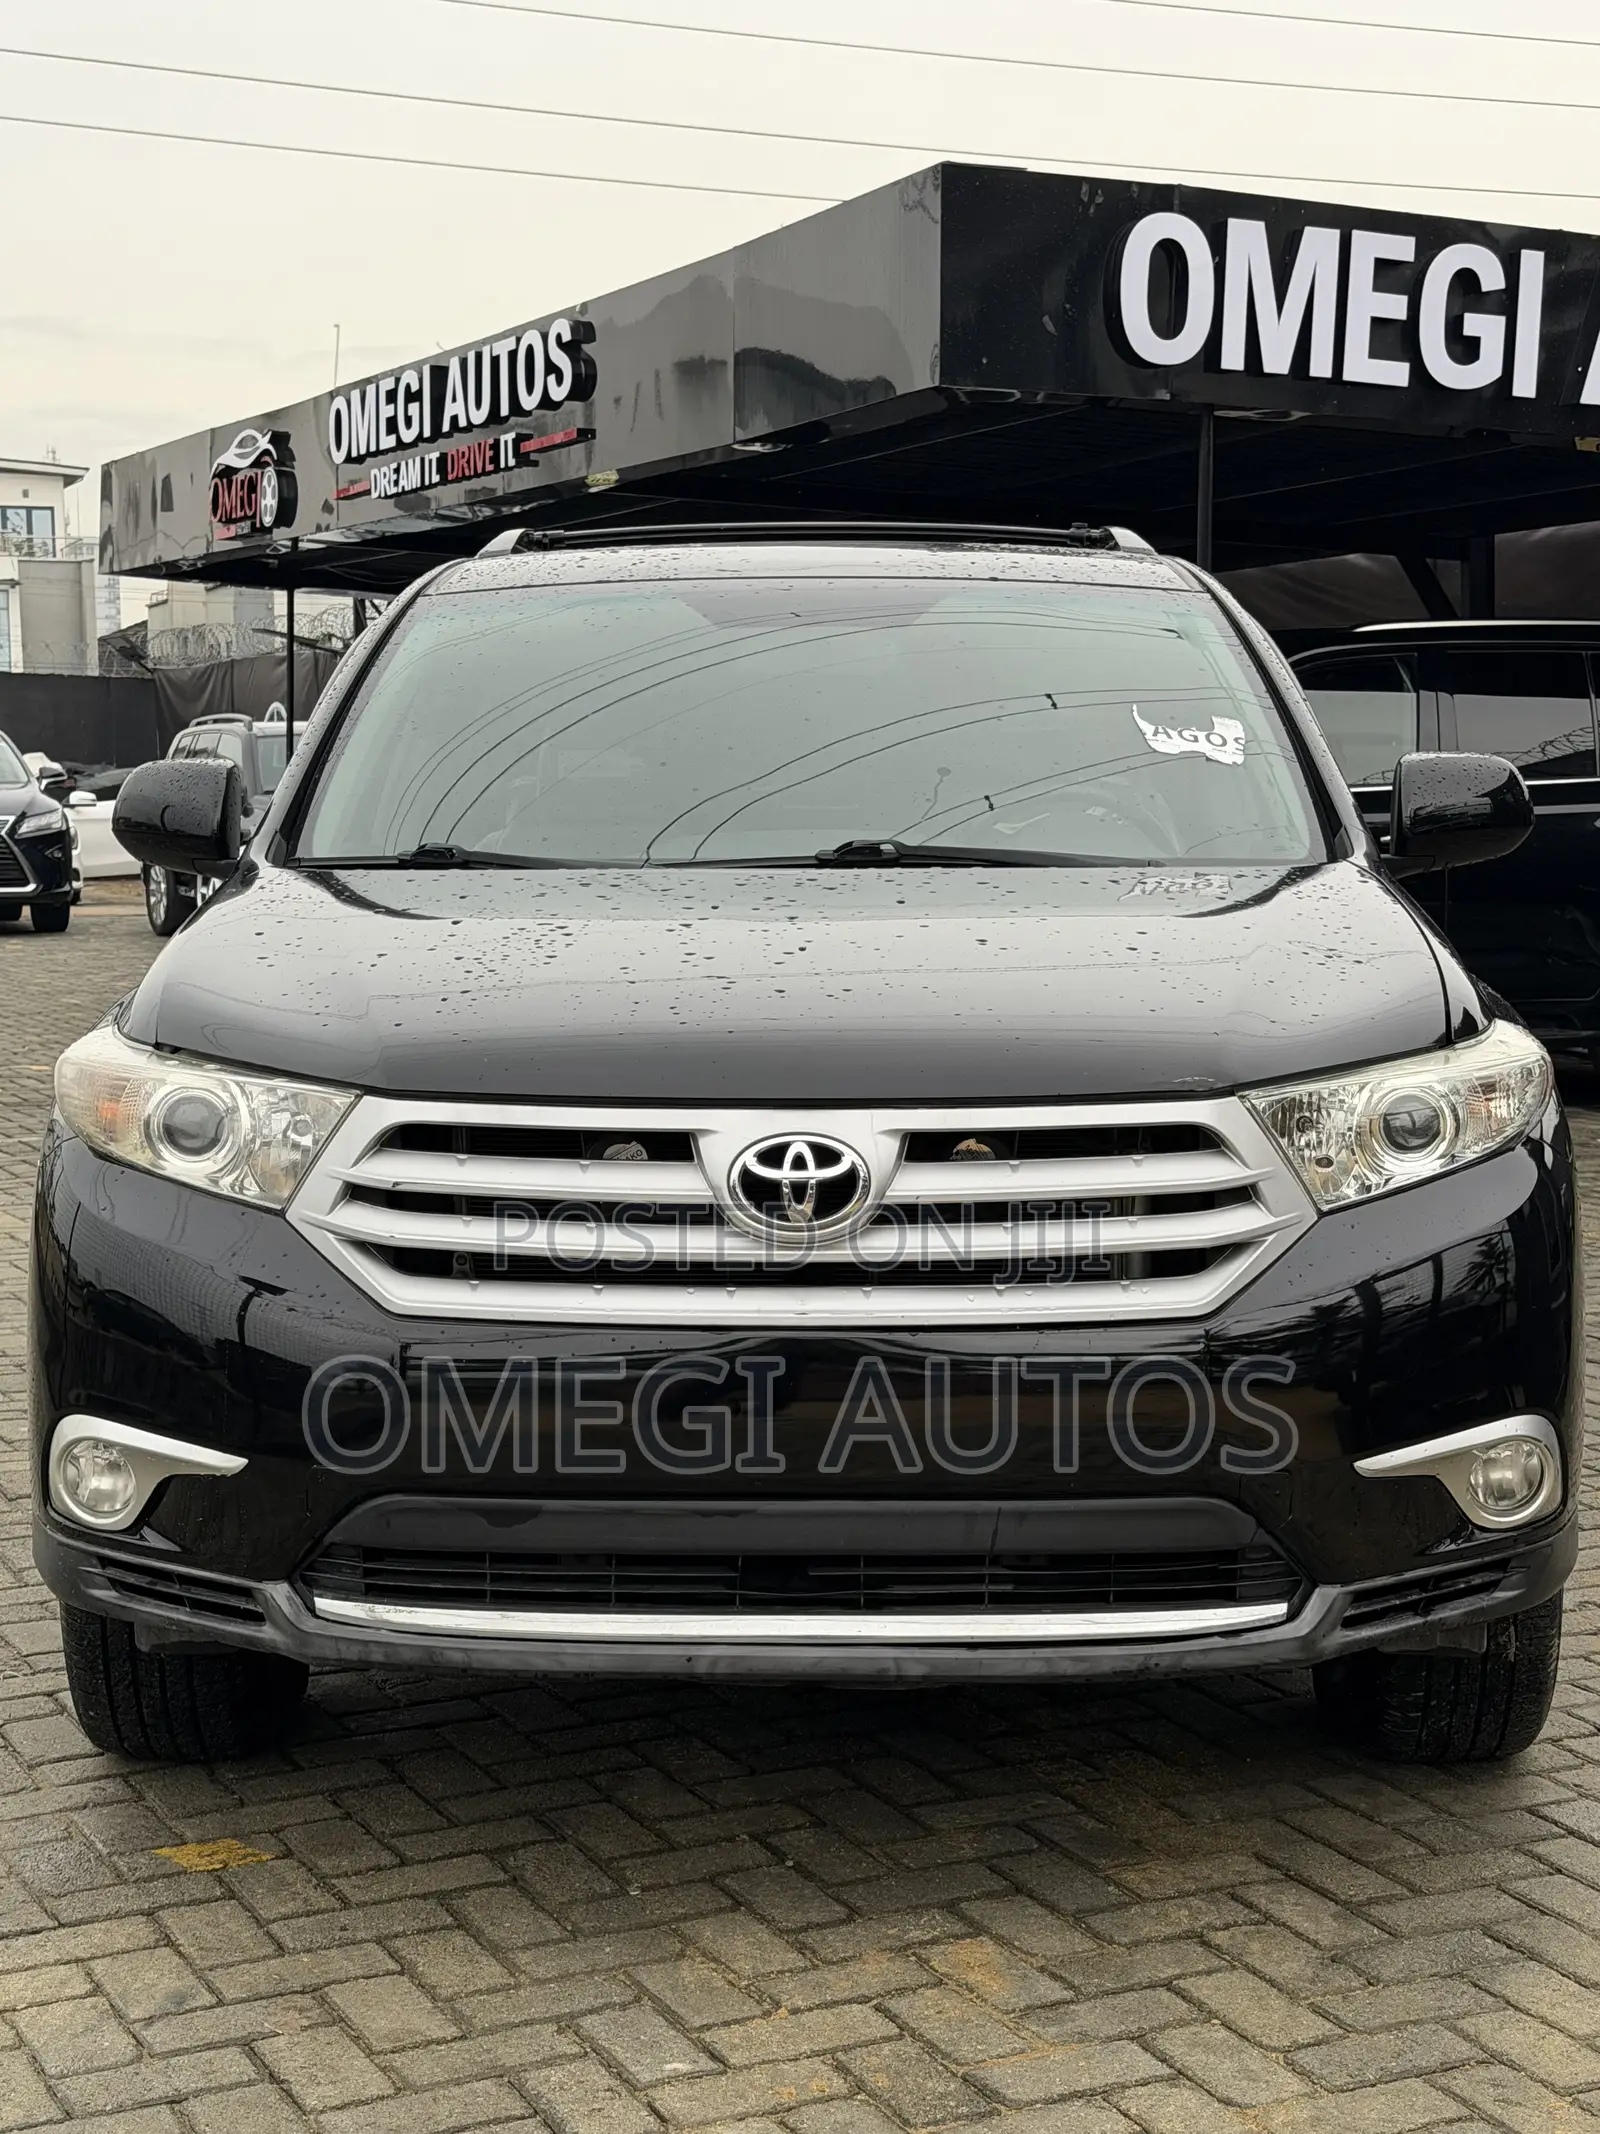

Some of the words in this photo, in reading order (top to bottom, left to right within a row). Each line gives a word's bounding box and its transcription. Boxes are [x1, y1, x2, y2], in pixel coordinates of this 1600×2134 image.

[1119, 211, 1546, 399] OMEGI
[328, 363, 432, 465] OMEGI
[441, 317, 573, 434] AUTOS
[369, 455, 422, 499] DREAM
[447, 437, 495, 481] DRIVE
